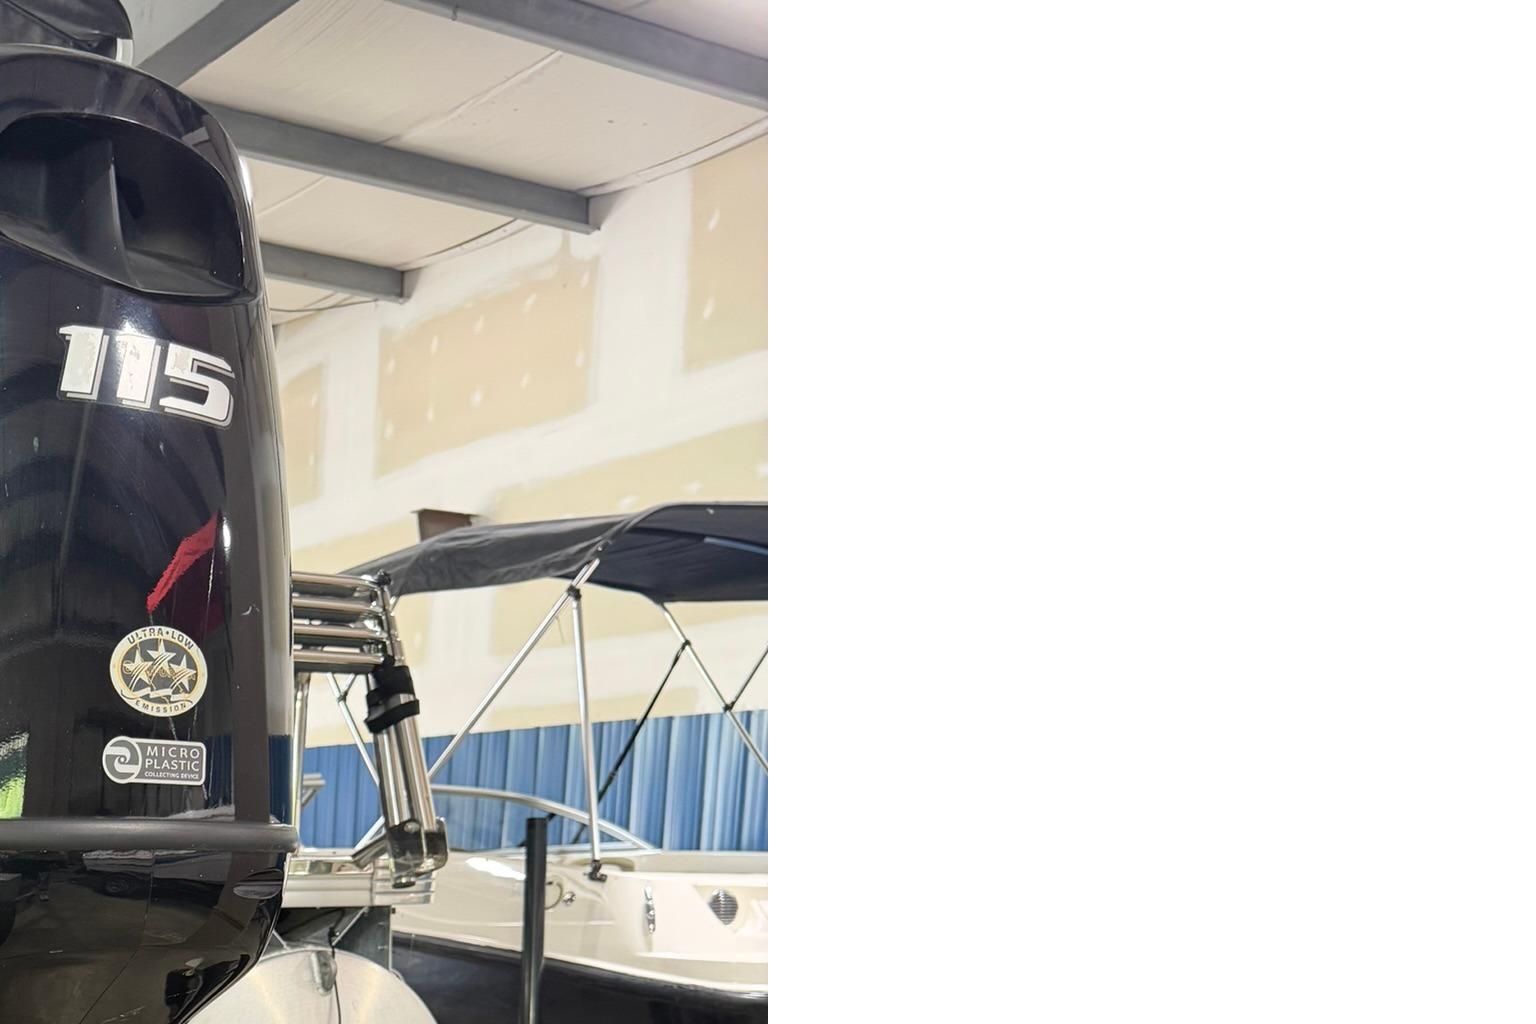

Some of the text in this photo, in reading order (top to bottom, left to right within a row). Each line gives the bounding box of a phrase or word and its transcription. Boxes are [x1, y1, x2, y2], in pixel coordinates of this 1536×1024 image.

[59, 325, 236, 427] 115
[135, 700, 187, 713] EMISSION
[146, 745, 200, 759] MICRO
[145, 758, 200, 771] PLASTIC
